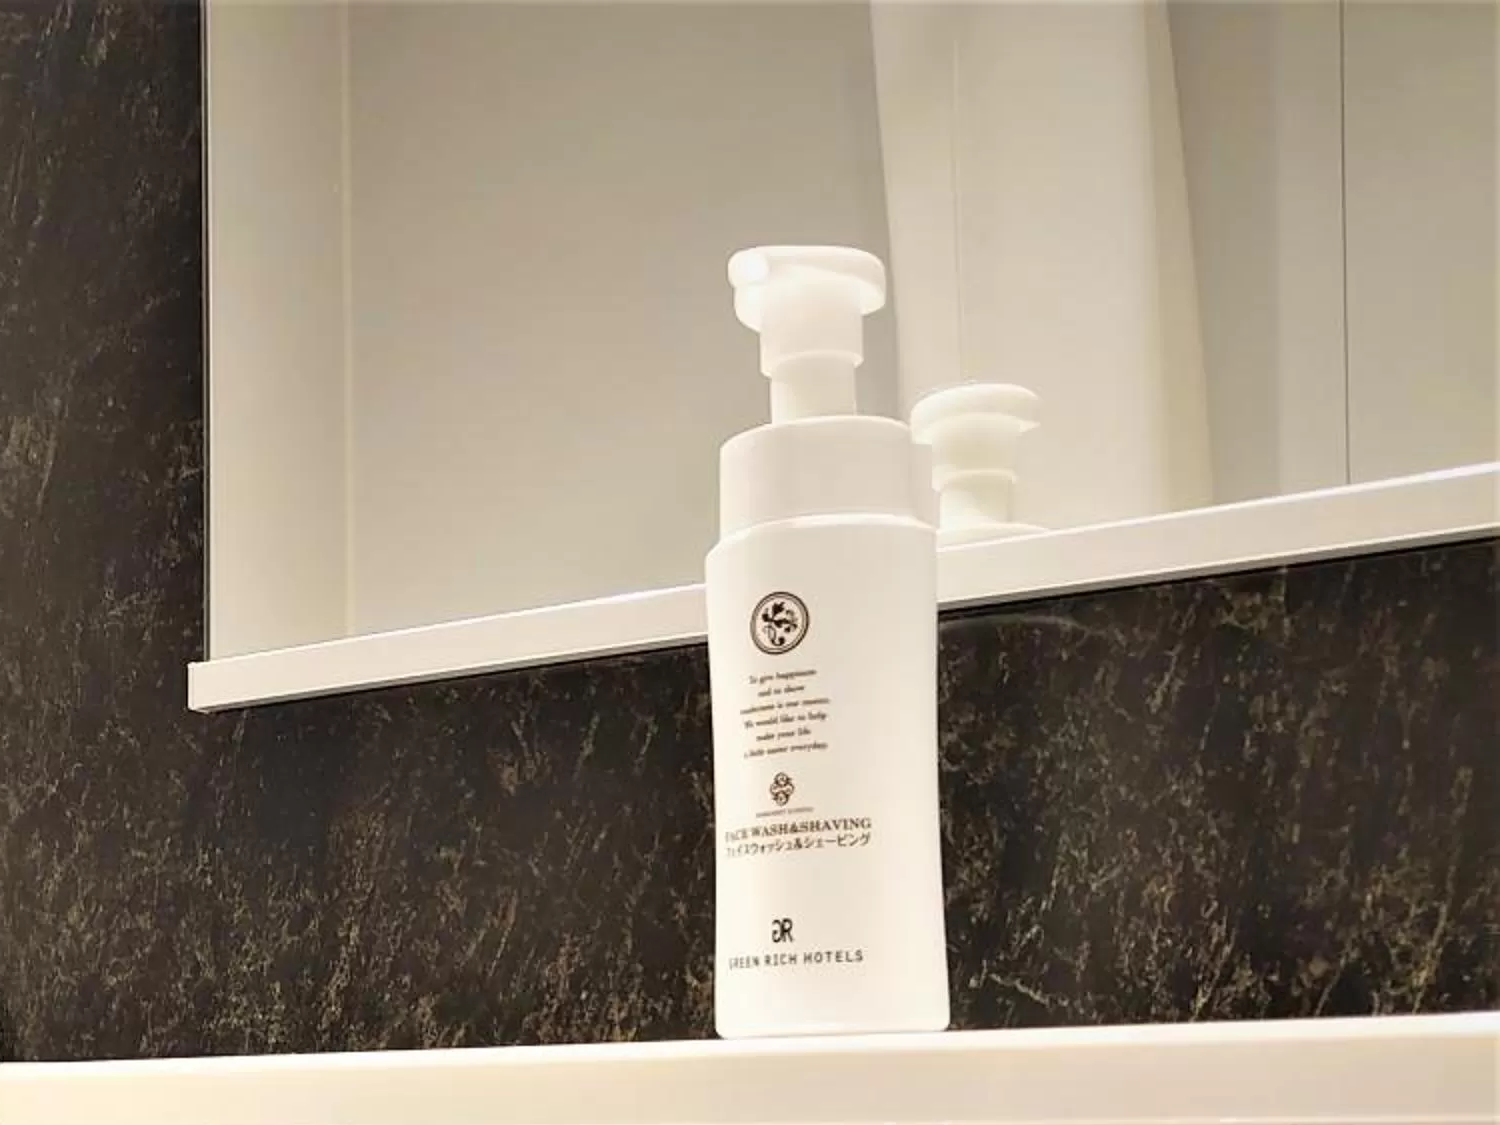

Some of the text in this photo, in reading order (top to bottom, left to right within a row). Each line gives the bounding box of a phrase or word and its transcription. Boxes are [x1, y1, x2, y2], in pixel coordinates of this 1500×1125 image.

[751, 818, 871, 837] WASH&SHAVING
[764, 953, 798, 967] RICH
[803, 949, 863, 965] HOTELS
